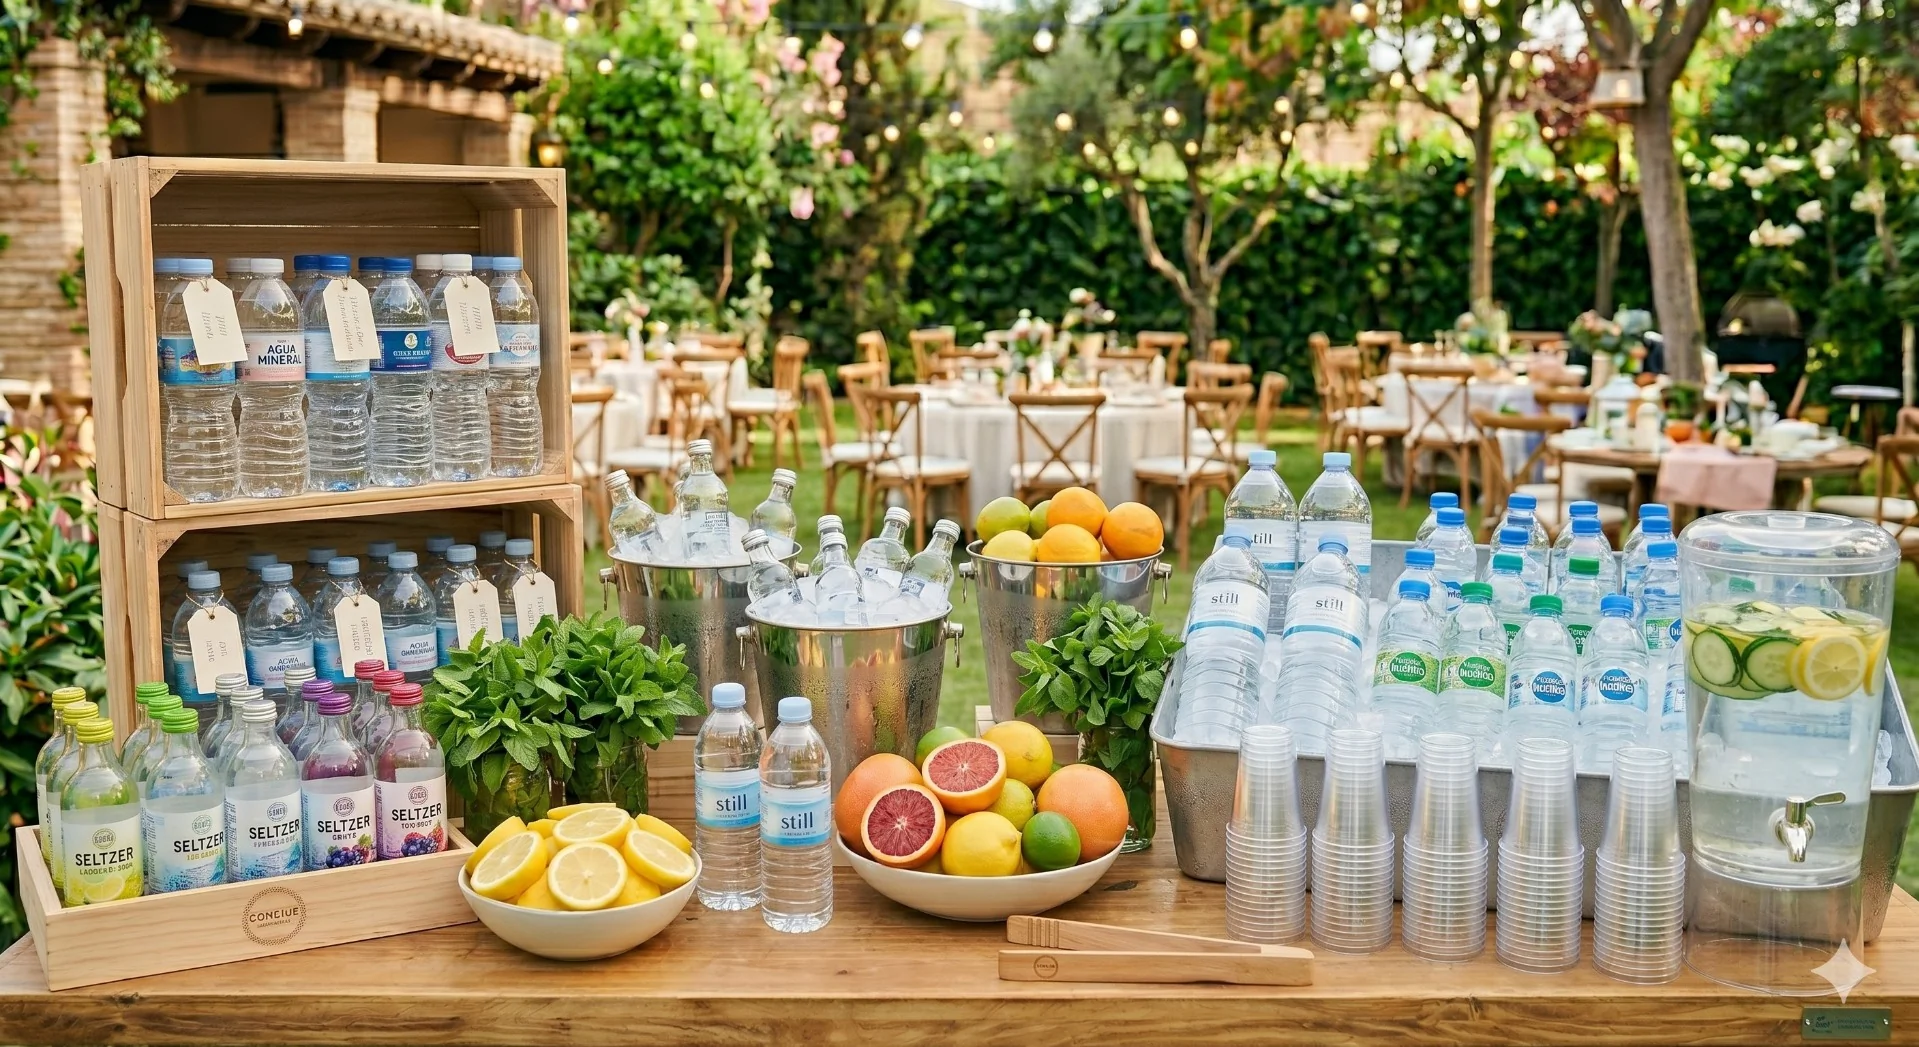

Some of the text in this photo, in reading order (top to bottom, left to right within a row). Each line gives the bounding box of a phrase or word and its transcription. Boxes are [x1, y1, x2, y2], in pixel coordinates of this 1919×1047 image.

[267, 344, 297, 355] AGUA
[258, 354, 302, 365] MINERAL
[1250, 532, 1272, 545] till
[1211, 592, 1239, 604] still
[1315, 597, 1344, 612] still
[391, 802, 442, 821] SELTZER
[716, 793, 747, 812] still
[249, 818, 300, 840] SELTZER
[317, 814, 370, 833] SELTZER
[781, 811, 814, 830] still
[173, 831, 225, 853] SELTZER
[75, 846, 134, 867] SELTZER
